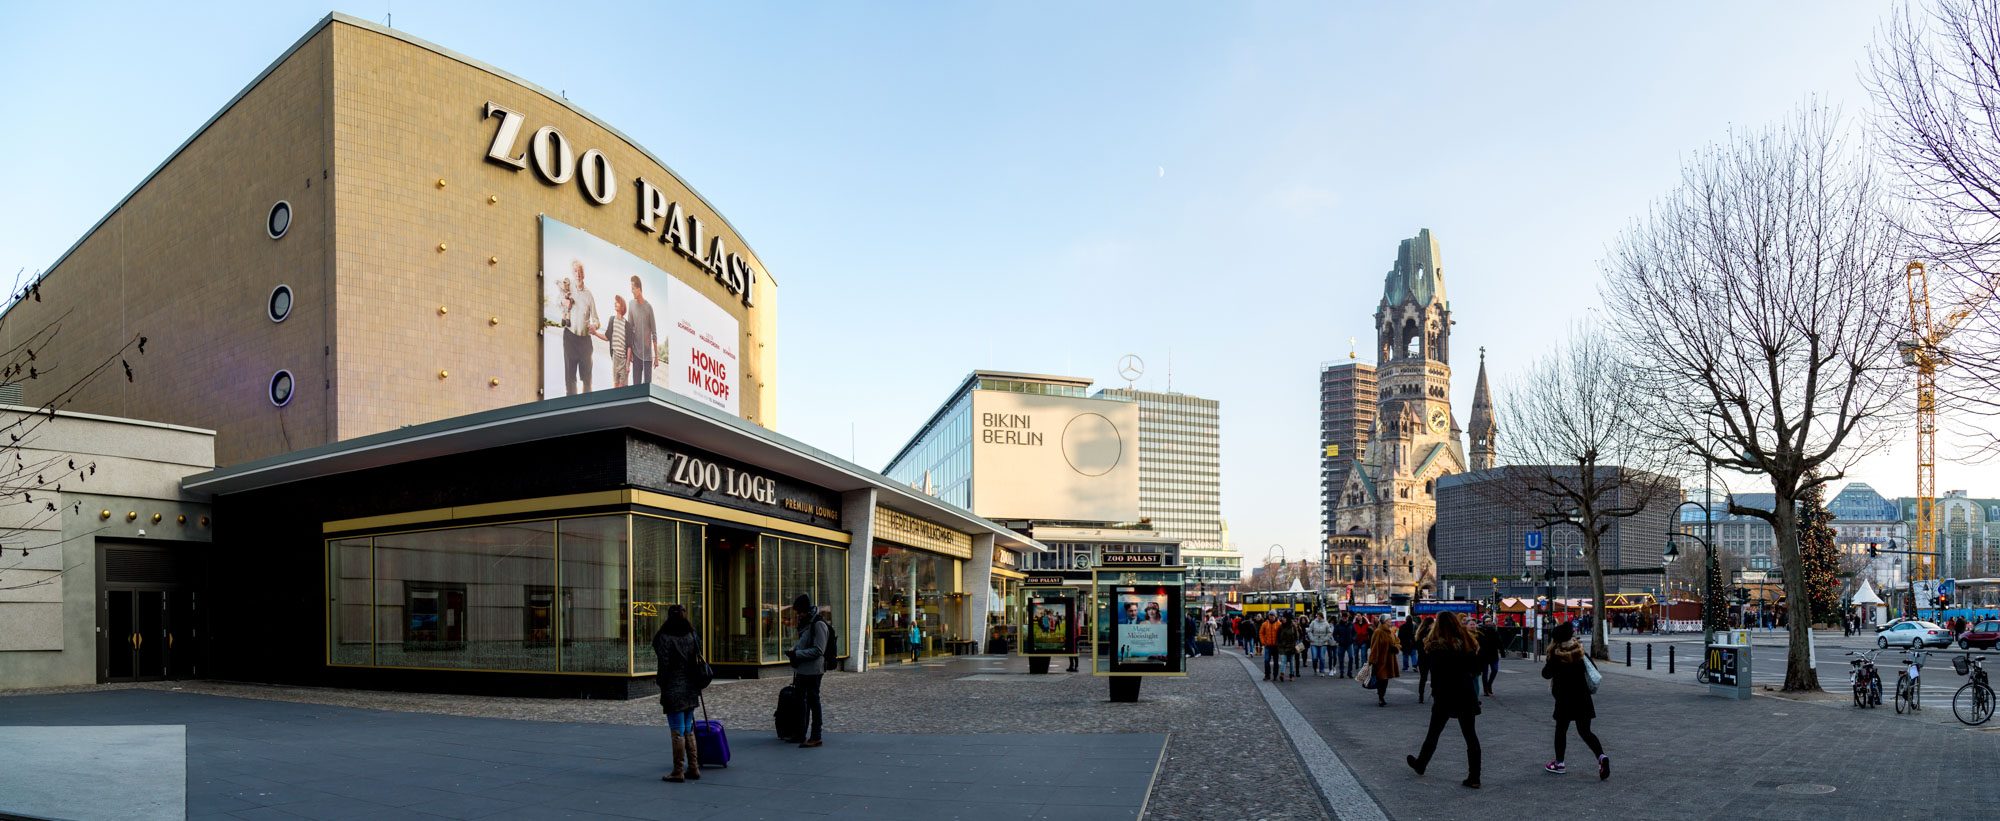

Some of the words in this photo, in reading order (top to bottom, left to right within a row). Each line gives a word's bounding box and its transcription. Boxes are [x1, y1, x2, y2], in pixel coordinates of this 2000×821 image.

[484, 100, 617, 206] ZOO
[636, 176, 757, 308] PALAST
[691, 347, 726, 381] HONIG
[688, 365, 702, 388] IM
[704, 374, 730, 401] KOPF
[983, 413, 1030, 429] BIKINI
[983, 429, 1043, 446] BERLIN
[673, 452, 720, 491] ZOO
[727, 466, 777, 506] LOGE
[784, 497, 814, 515] PREMIUM
[815, 504, 838, 521] LOUNGE
[1528, 534, 1538, 548] U
[1127, 632, 1159, 640] Moonlight
